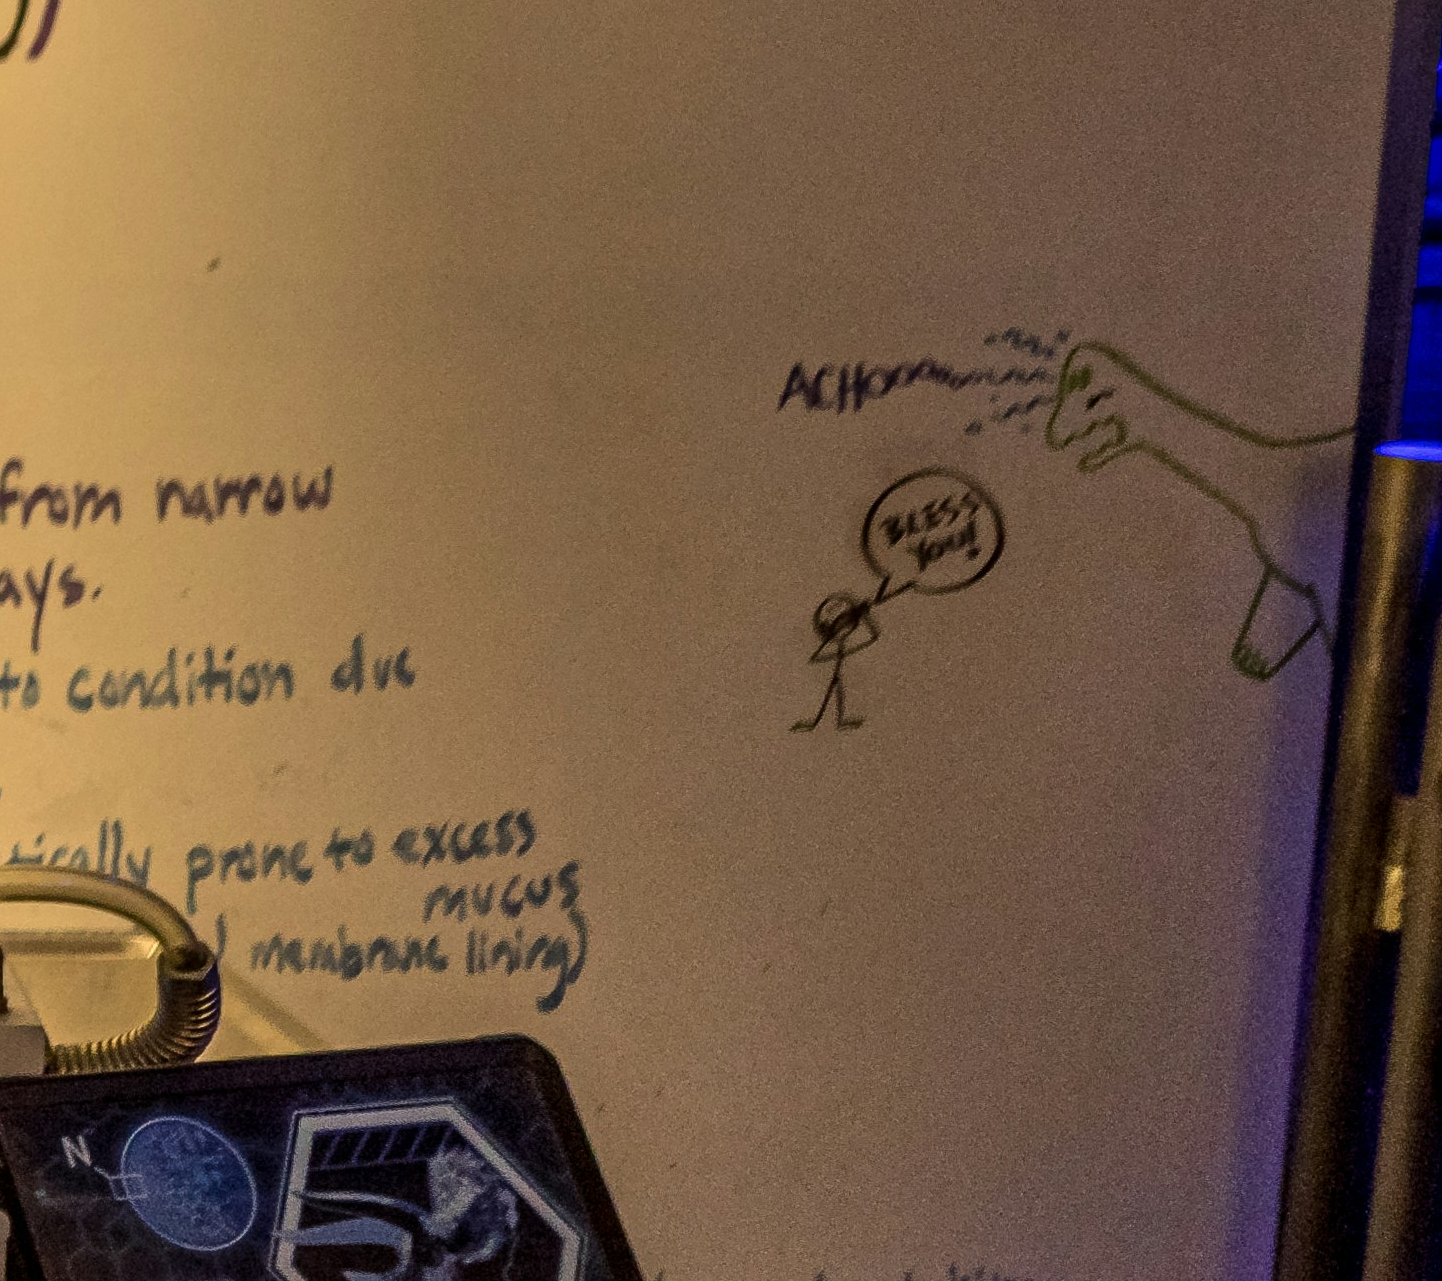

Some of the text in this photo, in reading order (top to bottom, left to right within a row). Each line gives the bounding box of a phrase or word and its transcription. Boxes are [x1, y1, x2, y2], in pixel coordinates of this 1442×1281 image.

[154, 463, 336, 524] narrow
[880, 490, 982, 550] BLESS
[65, 640, 295, 714] condition
[329, 630, 417, 696] due
[186, 839, 315, 916] prone
[322, 825, 376, 873] to
[390, 807, 538, 870] excess
[421, 859, 582, 924] mucus
[250, 924, 450, 982] membrane
